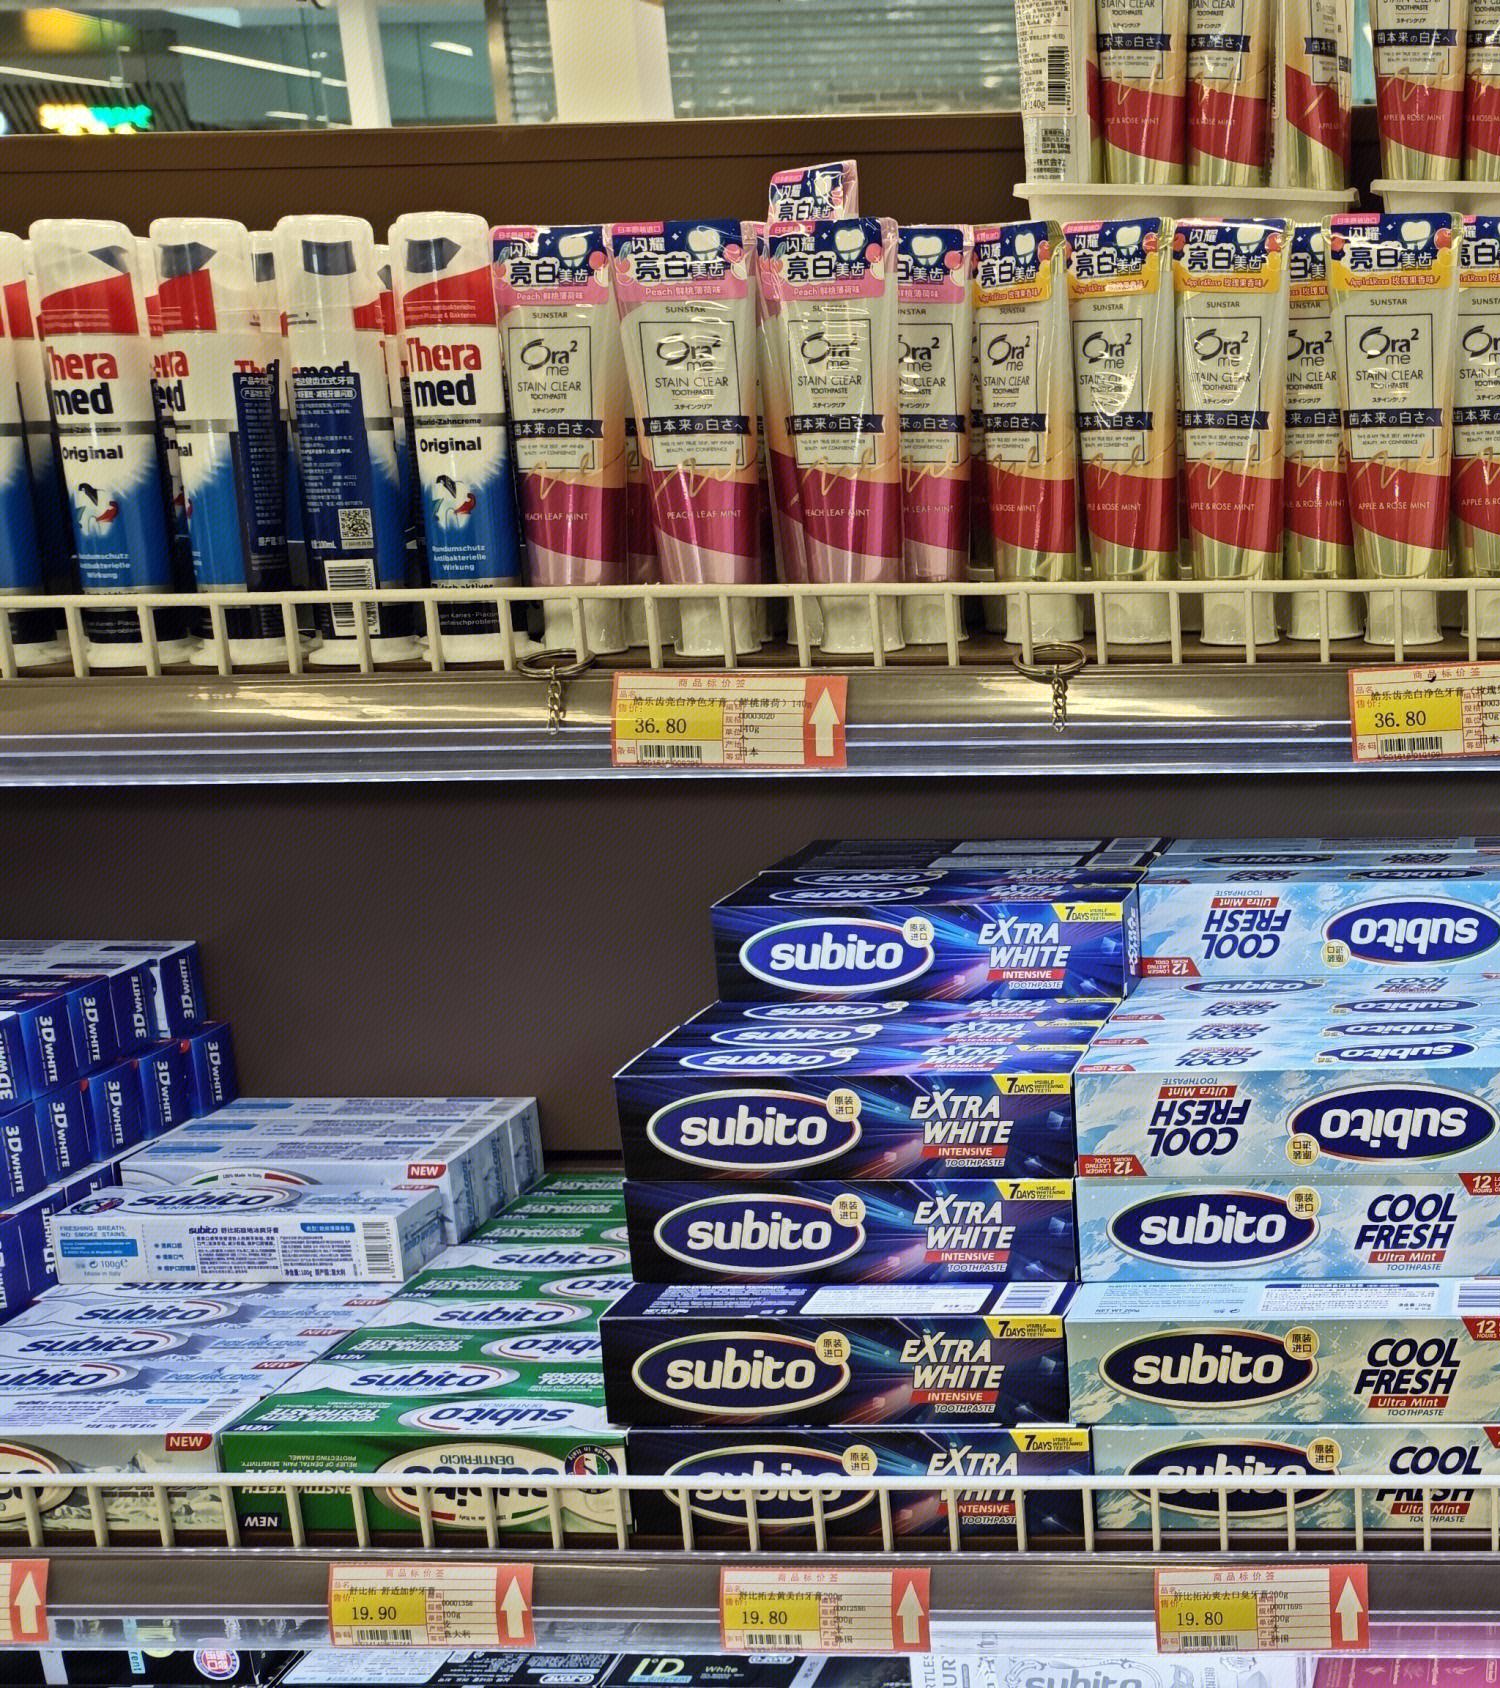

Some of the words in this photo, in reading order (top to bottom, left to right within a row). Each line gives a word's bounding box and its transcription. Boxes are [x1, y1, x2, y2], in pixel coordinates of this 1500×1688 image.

[631, 234, 665, 252] 闪耀
[645, 286, 673, 297] Peach
[1206, 301, 1240, 309] SUNSTAR
[1369, 298, 1407, 306] SUNSTAR
[686, 361, 714, 372] me
[1385, 354, 1411, 366] me
[655, 375, 690, 388] STAIN
[693, 375, 729, 388] CLEAR
[1355, 369, 1388, 382] STAIN
[1391, 369, 1424, 382] CLEAR
[54, 382, 114, 415] med
[414, 374, 477, 407] med
[671, 388, 714, 396] TOOTHPASTE
[650, 418, 745, 433] 歯本来の白さへ
[1350, 412, 1436, 427] 歯本来の白さへ
[62, 445, 124, 462] Original
[420, 436, 482, 454] Original
[1358, 501, 1380, 511] APPLE
[1388, 501, 1407, 510] ROSE
[1409, 501, 1431, 510] MINT
[666, 511, 694, 520] PEACH
[696, 511, 717, 520] LEAF
[720, 510, 741, 519] MINT
[634, 718, 687, 734] 36.80
[1374, 710, 1427, 728] 36.80
[1203, 909, 1291, 934] FRESH
[978, 916, 1060, 945] EXTRA
[1350, 917, 1480, 955] subito
[769, 932, 904, 971] subito
[1203, 932, 1280, 960] COOL
[989, 944, 1071, 969] WHITE
[1001, 970, 1053, 980] INTENSIVE
[834, 1095, 854, 1106] 原装
[909, 1087, 1002, 1119] EXTRA
[834, 1105, 854, 1116] 进口
[1149, 1098, 1252, 1127] FRESH
[679, 1104, 828, 1147] subito
[921, 1118, 1014, 1145] WHITE
[1319, 1107, 1469, 1149] subito
[1147, 1126, 1236, 1157] COOL
[410, 1166, 440, 1177] NEW
[913, 1193, 1003, 1225] EXTRA
[1367, 1192, 1459, 1223] COOL
[687, 1209, 832, 1250] subito
[1139, 1203, 1288, 1245] subito
[1353, 1223, 1455, 1250] FRESH
[1376, 1252, 1407, 1262] Ultra
[1410, 1252, 1437, 1262] Mint
[433, 1306, 565, 1322] subito
[664, 1347, 816, 1390] subito
[1132, 1343, 1284, 1385] subito
[169, 1437, 204, 1448] NEW
[439, 1454, 516, 1467] DENTIFRICIO
[352, 1606, 397, 1621] 19.90
[742, 1611, 788, 1625] 19.80
[1177, 1611, 1223, 1626] 19.80
